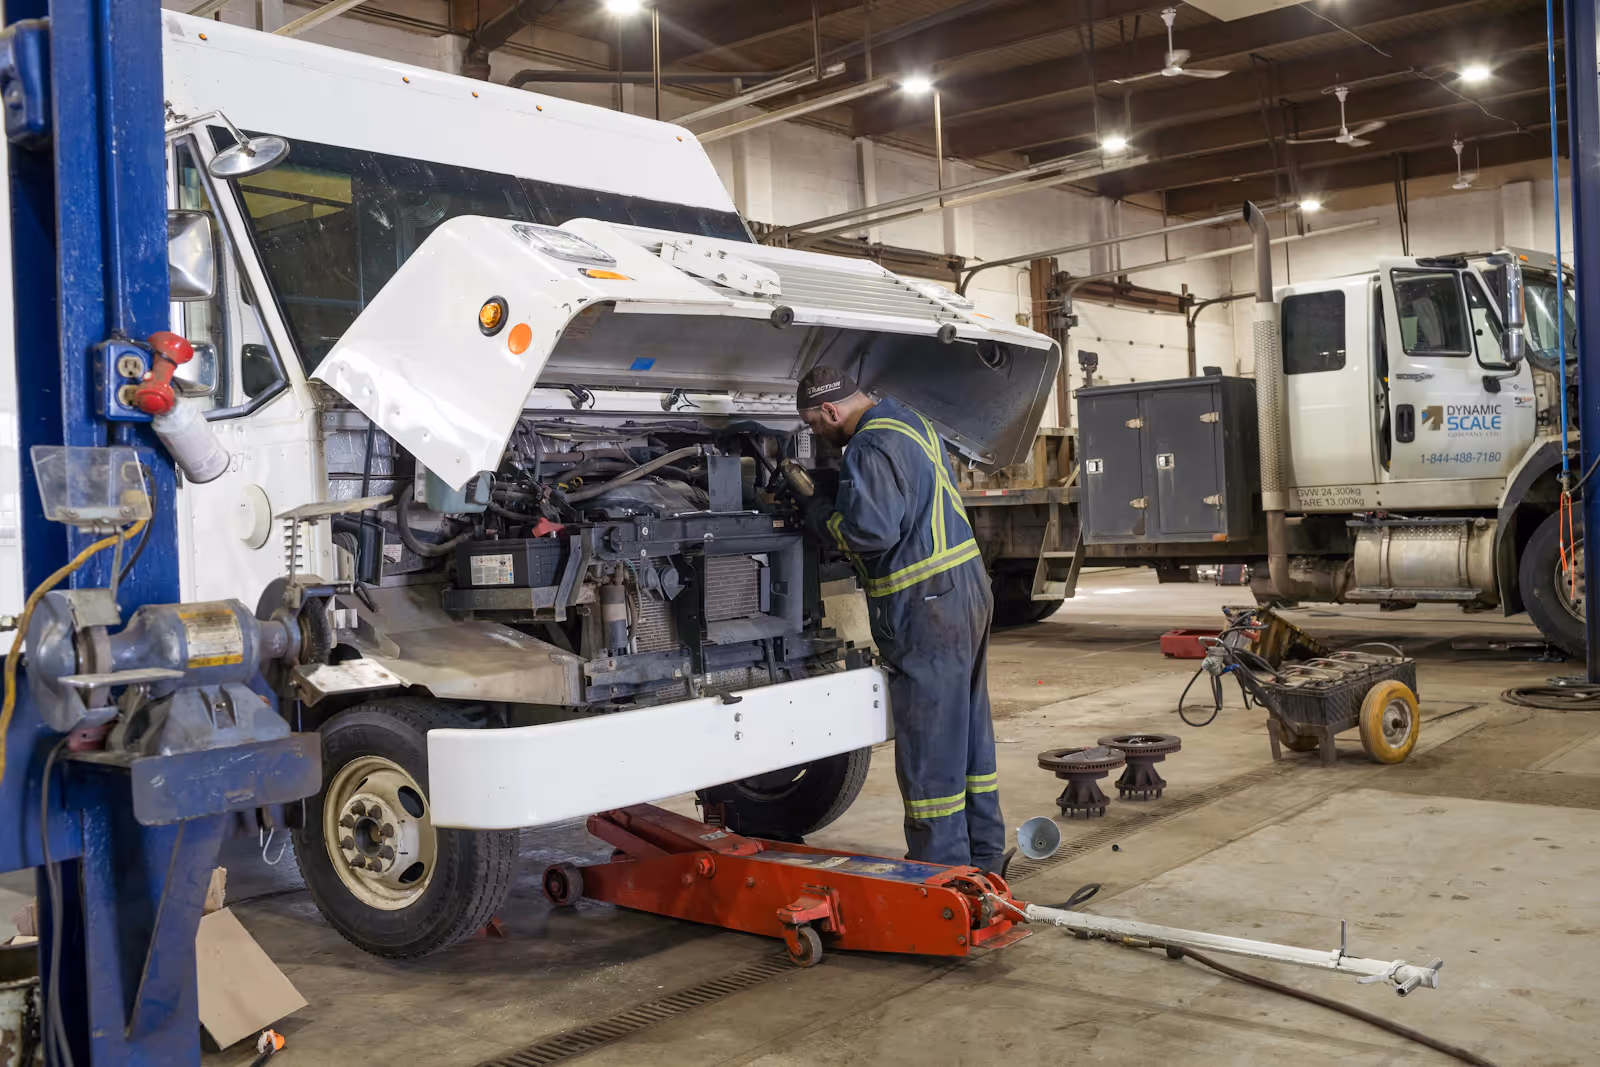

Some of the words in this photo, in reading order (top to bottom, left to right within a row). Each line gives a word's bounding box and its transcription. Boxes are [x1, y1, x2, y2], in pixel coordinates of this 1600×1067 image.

[808, 381, 840, 395] TRACTION
[1447, 404, 1501, 416] DYNAMIC
[1447, 415, 1501, 431] SCALE
[1421, 451, 1502, 464] 1-844-488-7180
[1297, 488, 1319, 497] GVW
[1322, 487, 1361, 497] 24,300kg
[1298, 499, 1322, 507] TARE
